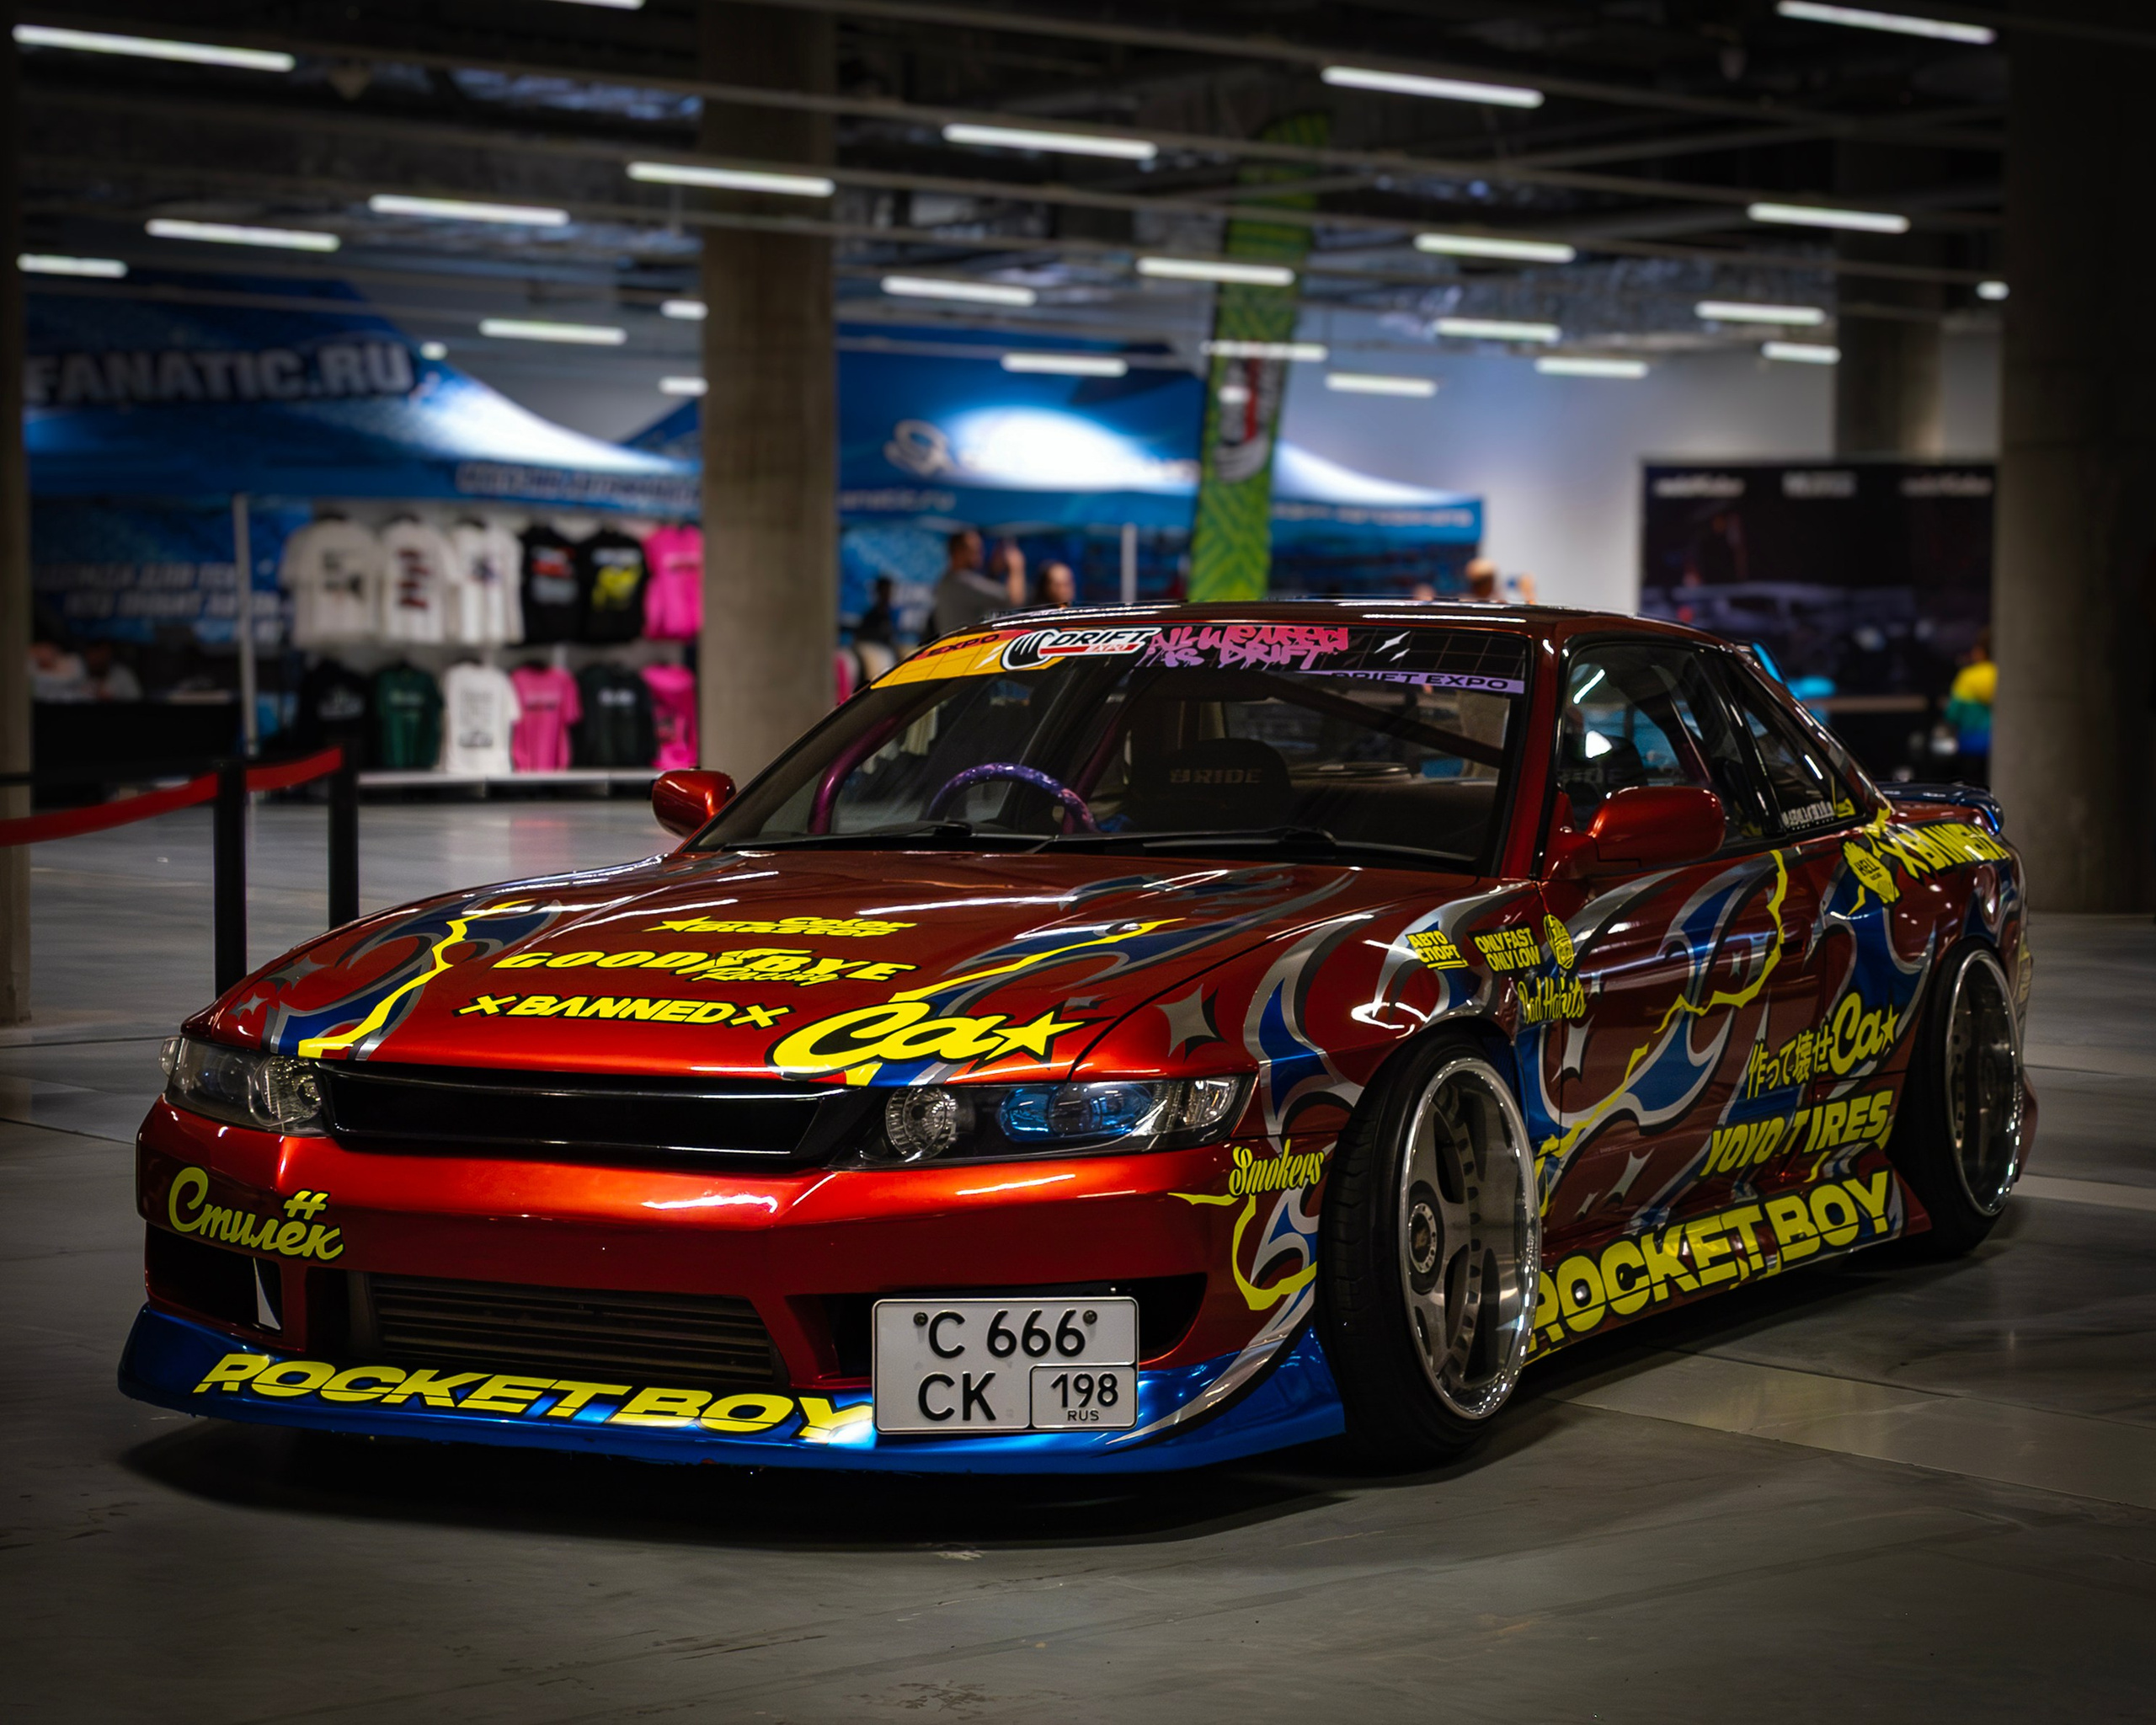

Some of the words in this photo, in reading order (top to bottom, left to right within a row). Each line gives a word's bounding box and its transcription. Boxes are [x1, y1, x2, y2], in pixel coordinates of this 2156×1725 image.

[927, 634, 1000, 656] EXPO
[1049, 630, 1156, 647] DRIFT
[1219, 642, 1325, 670] DRIFT
[1425, 675, 1508, 690] EXPO
[1407, 932, 1449, 948] АВТО
[1475, 933, 1510, 953] ONLY
[1506, 927, 1534, 951] FAST
[1415, 944, 1461, 963] СПОРТ
[1486, 949, 1519, 972] ONLY
[1516, 945, 1541, 968] LOW
[691, 967, 840, 986] Racing
[1700, 1117, 1785, 1177] YOYO
[1782, 1090, 1893, 1155] TIRES
[1229, 1139, 1325, 1196] Smokers
[986, 1309, 1086, 1358] 666
[1050, 1373, 1118, 1407] 198
[1067, 1410, 1099, 1421] RUS
